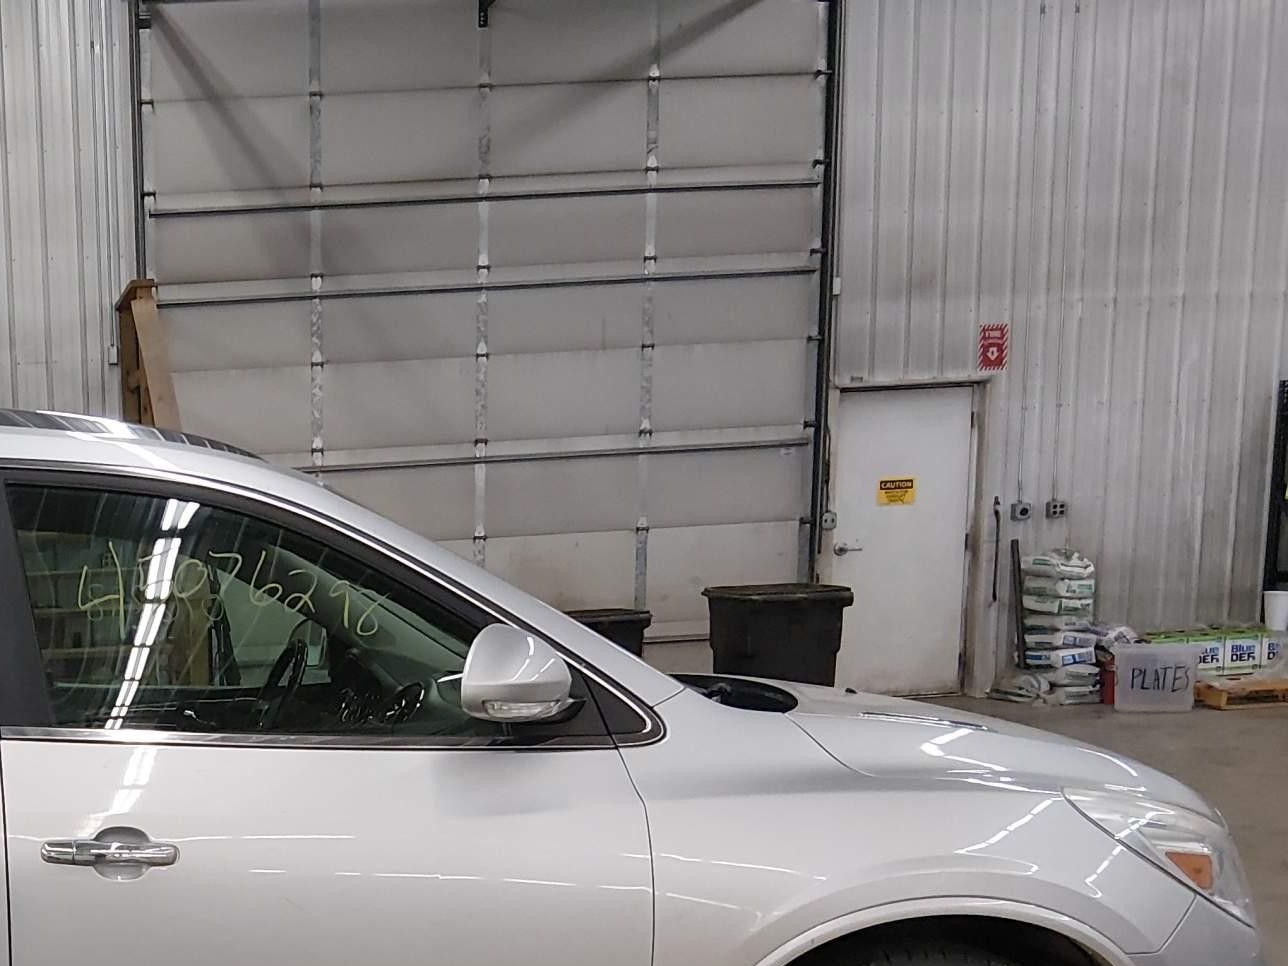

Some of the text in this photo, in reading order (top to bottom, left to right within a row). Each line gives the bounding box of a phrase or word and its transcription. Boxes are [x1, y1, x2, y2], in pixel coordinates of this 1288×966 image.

[880, 480, 913, 489] CAUTION
[1230, 651, 1256, 662] DEF
[1131, 665, 1191, 693] PLATES
